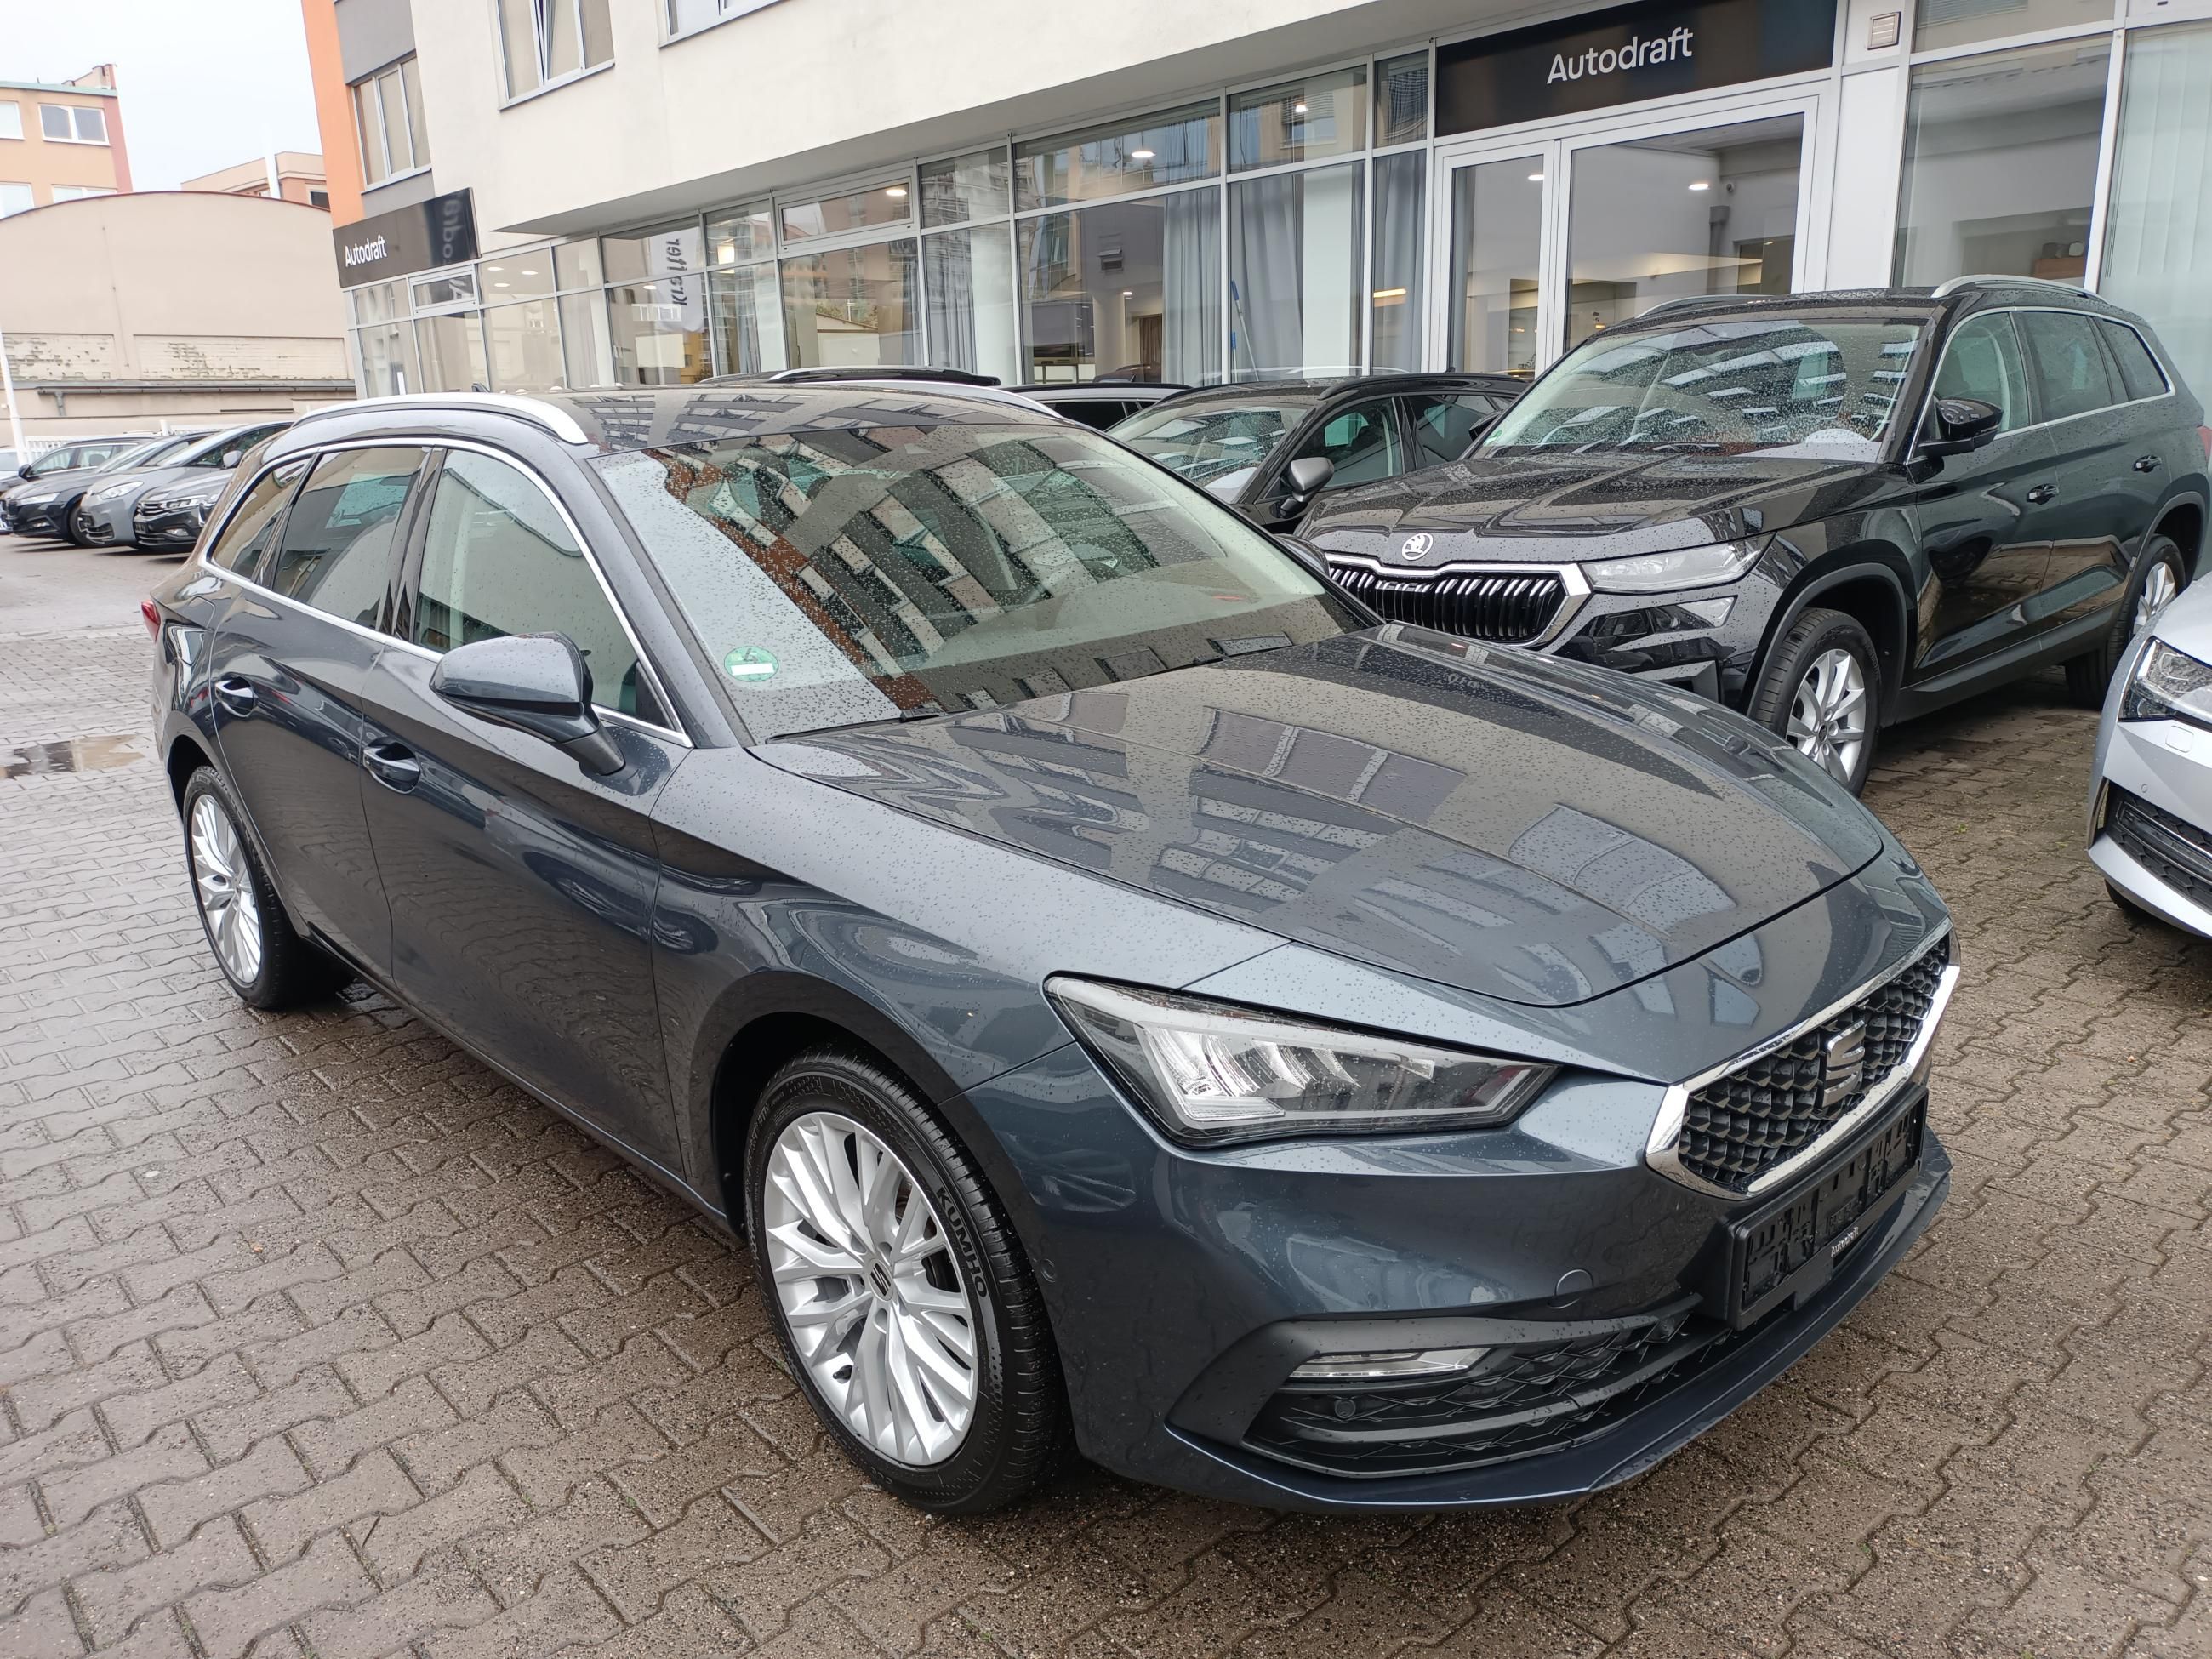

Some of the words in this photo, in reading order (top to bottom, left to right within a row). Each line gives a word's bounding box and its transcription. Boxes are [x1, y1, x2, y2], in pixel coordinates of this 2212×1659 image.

[1547, 26, 1693, 84] Autodraft
[345, 234, 387, 267] Autodraft
[936, 1186, 987, 1297] KUMHO
